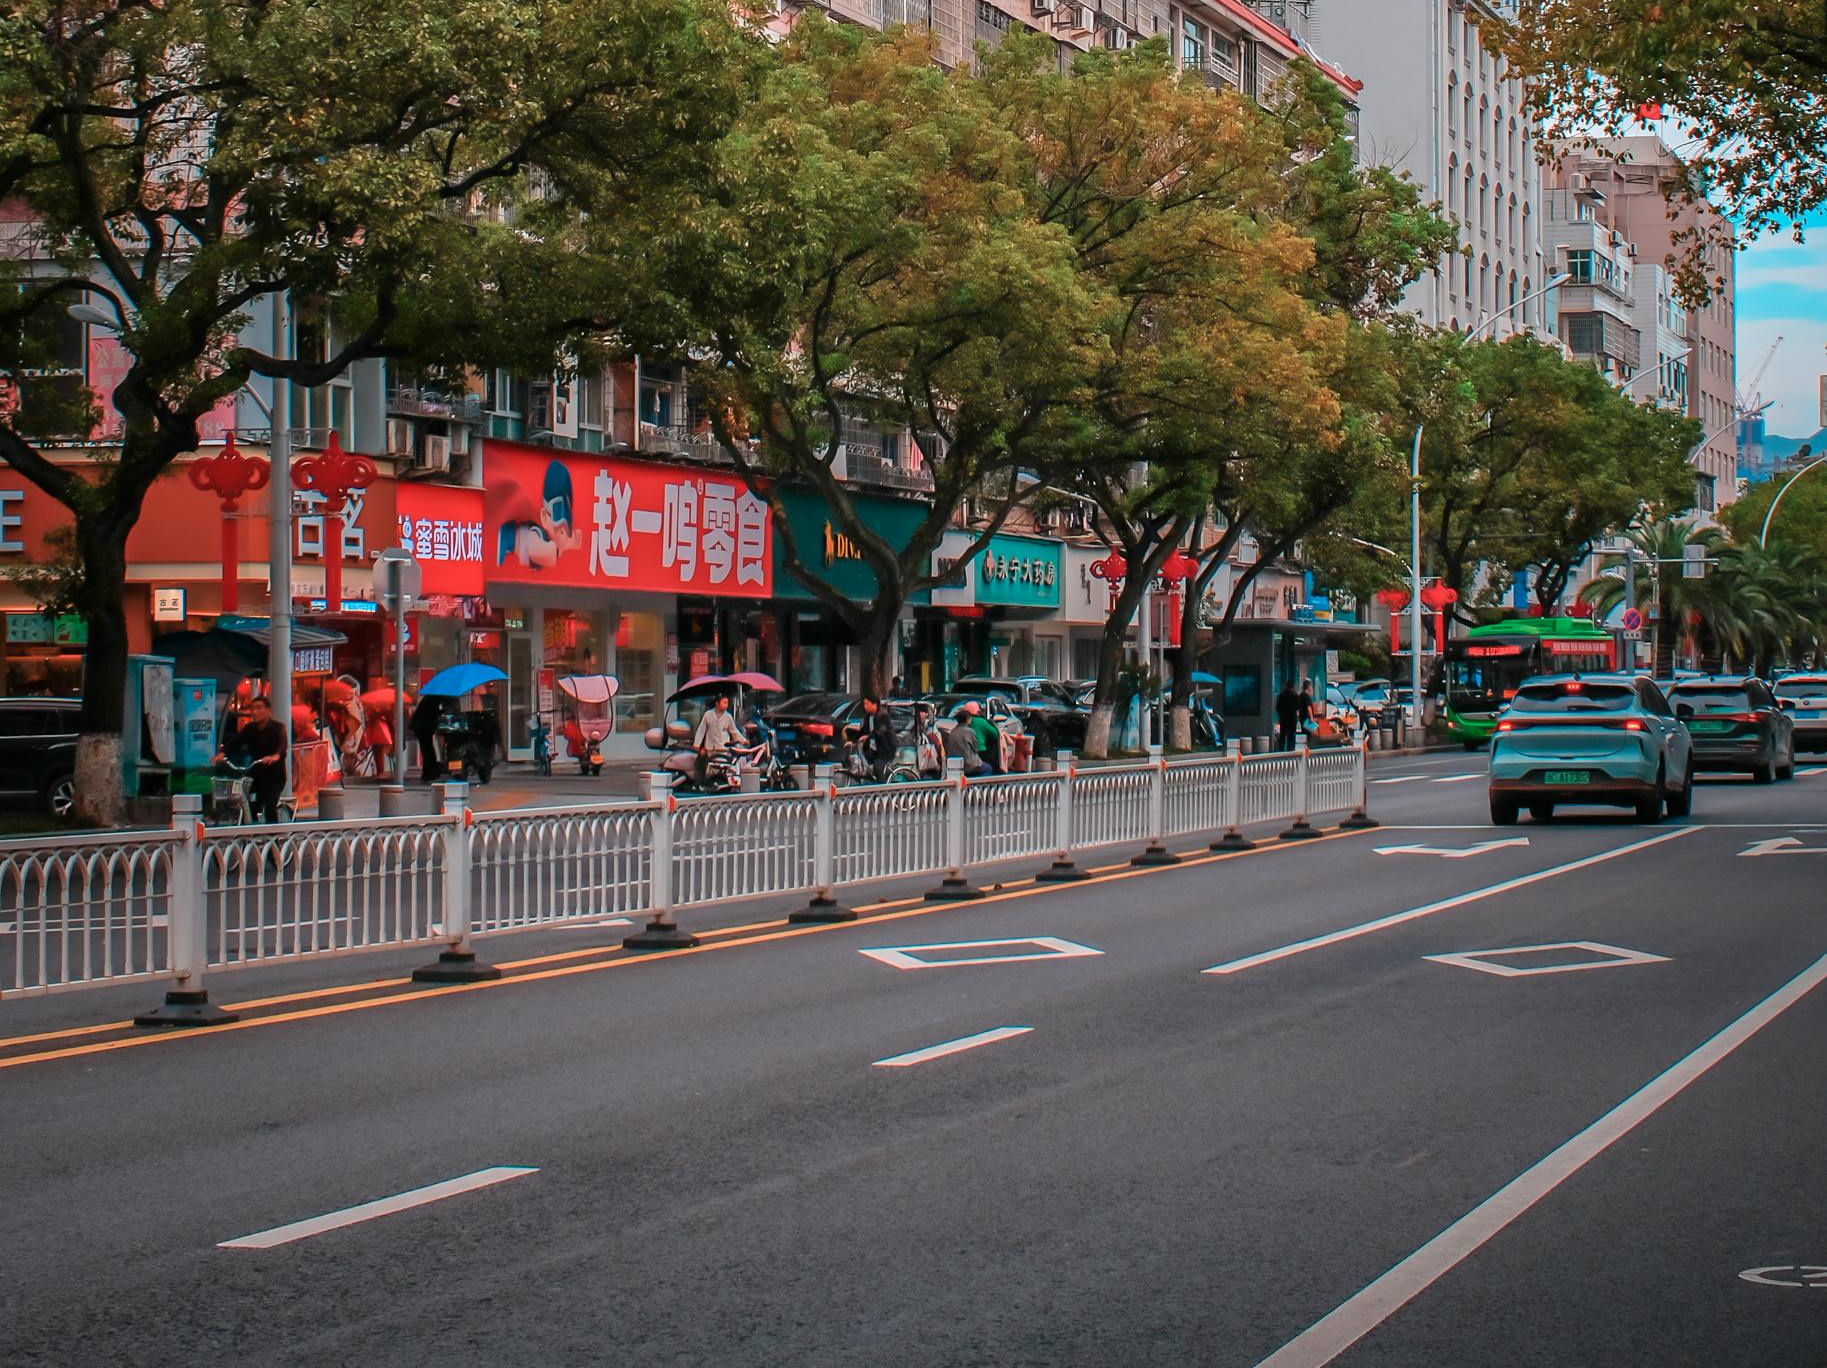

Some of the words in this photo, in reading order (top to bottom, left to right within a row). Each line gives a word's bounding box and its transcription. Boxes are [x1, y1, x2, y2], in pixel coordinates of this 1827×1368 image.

[415, 518, 483, 562] 蜜雪冰城
[589, 469, 768, 586] 赵一鸣零食
